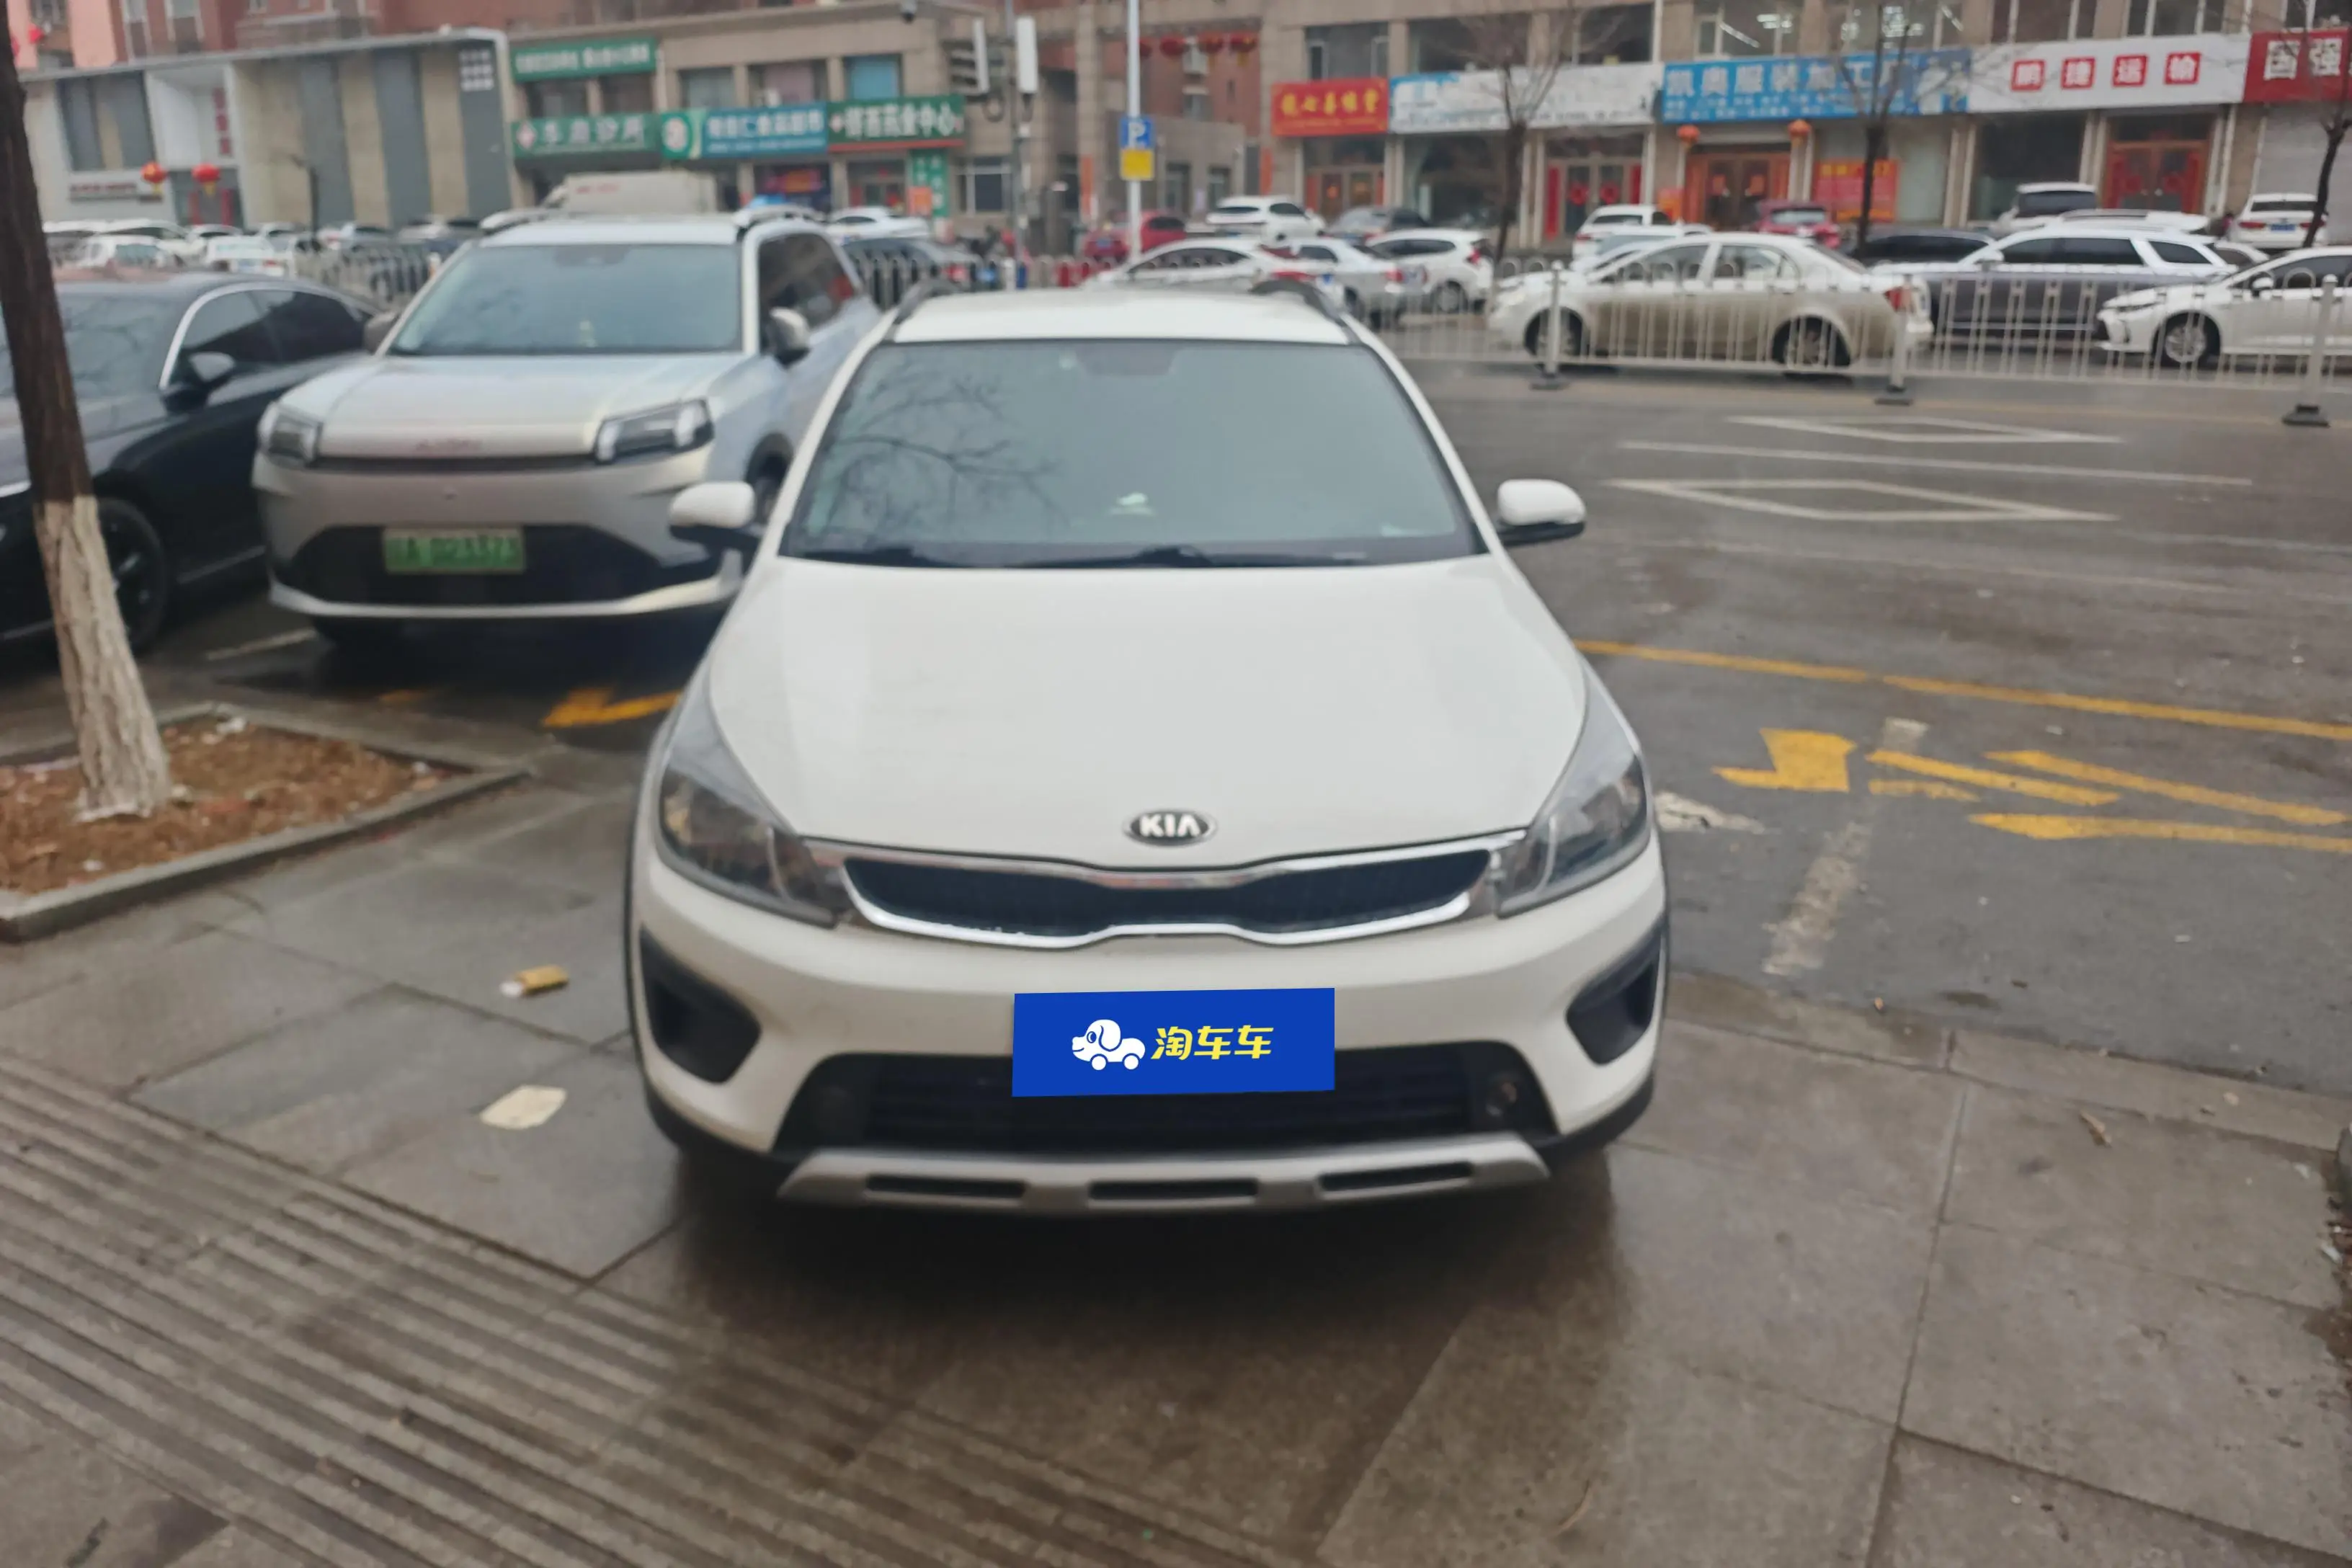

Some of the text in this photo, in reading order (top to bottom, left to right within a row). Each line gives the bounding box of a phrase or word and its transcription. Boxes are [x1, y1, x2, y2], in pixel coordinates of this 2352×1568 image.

[2263, 37, 2352, 81] 国强
[1128, 121, 1146, 148] P
[1139, 814, 1202, 837] KIA
